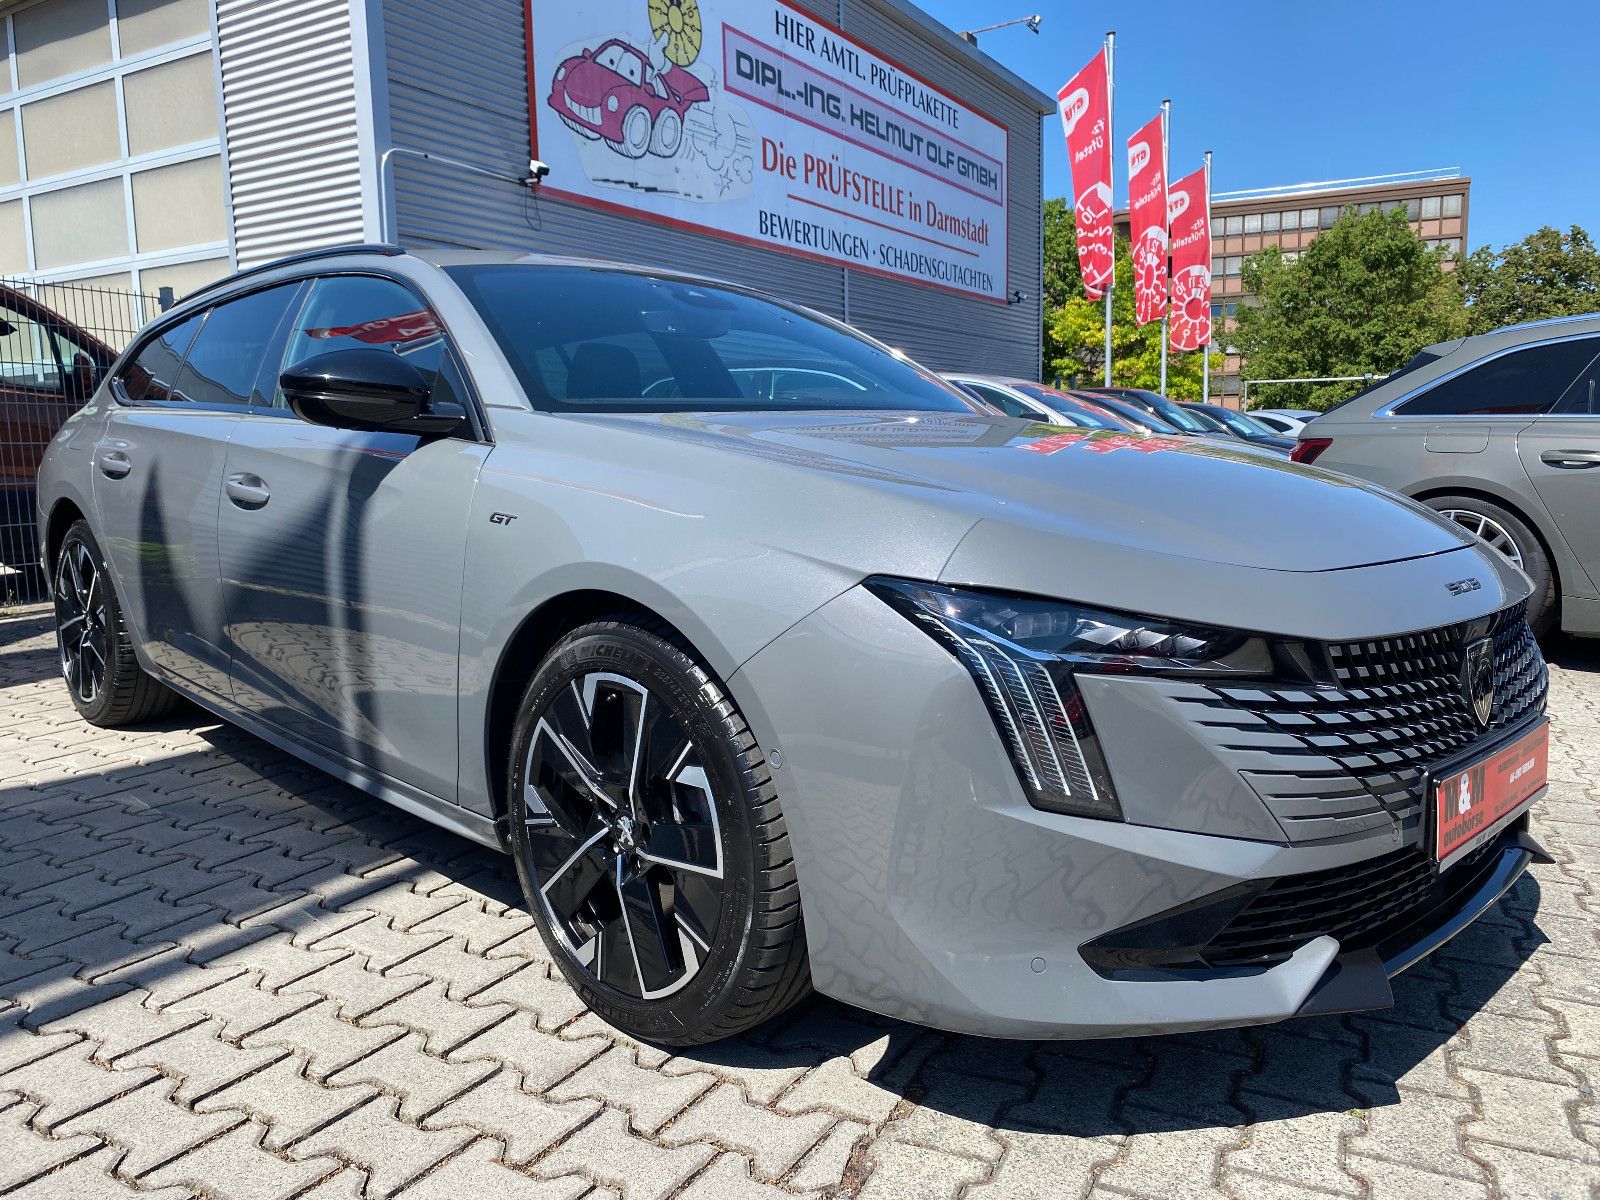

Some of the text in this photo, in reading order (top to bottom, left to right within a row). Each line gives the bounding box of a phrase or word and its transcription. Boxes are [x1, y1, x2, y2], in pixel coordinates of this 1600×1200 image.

[775, 10, 959, 130] HIER AMTL. PRÜFPLAKETTE
[850, 103, 924, 156] HELMUT
[926, 141, 955, 169] OLF
[761, 136, 990, 246] Die PRÜFSTELLE in Darmstadt
[759, 209, 993, 292] BEWERTUNGEN SCHADENSGUTACHTEN
[489, 511, 518, 526] GT
[1444, 577, 1482, 597] 508
[1444, 764, 1486, 823] M&M
